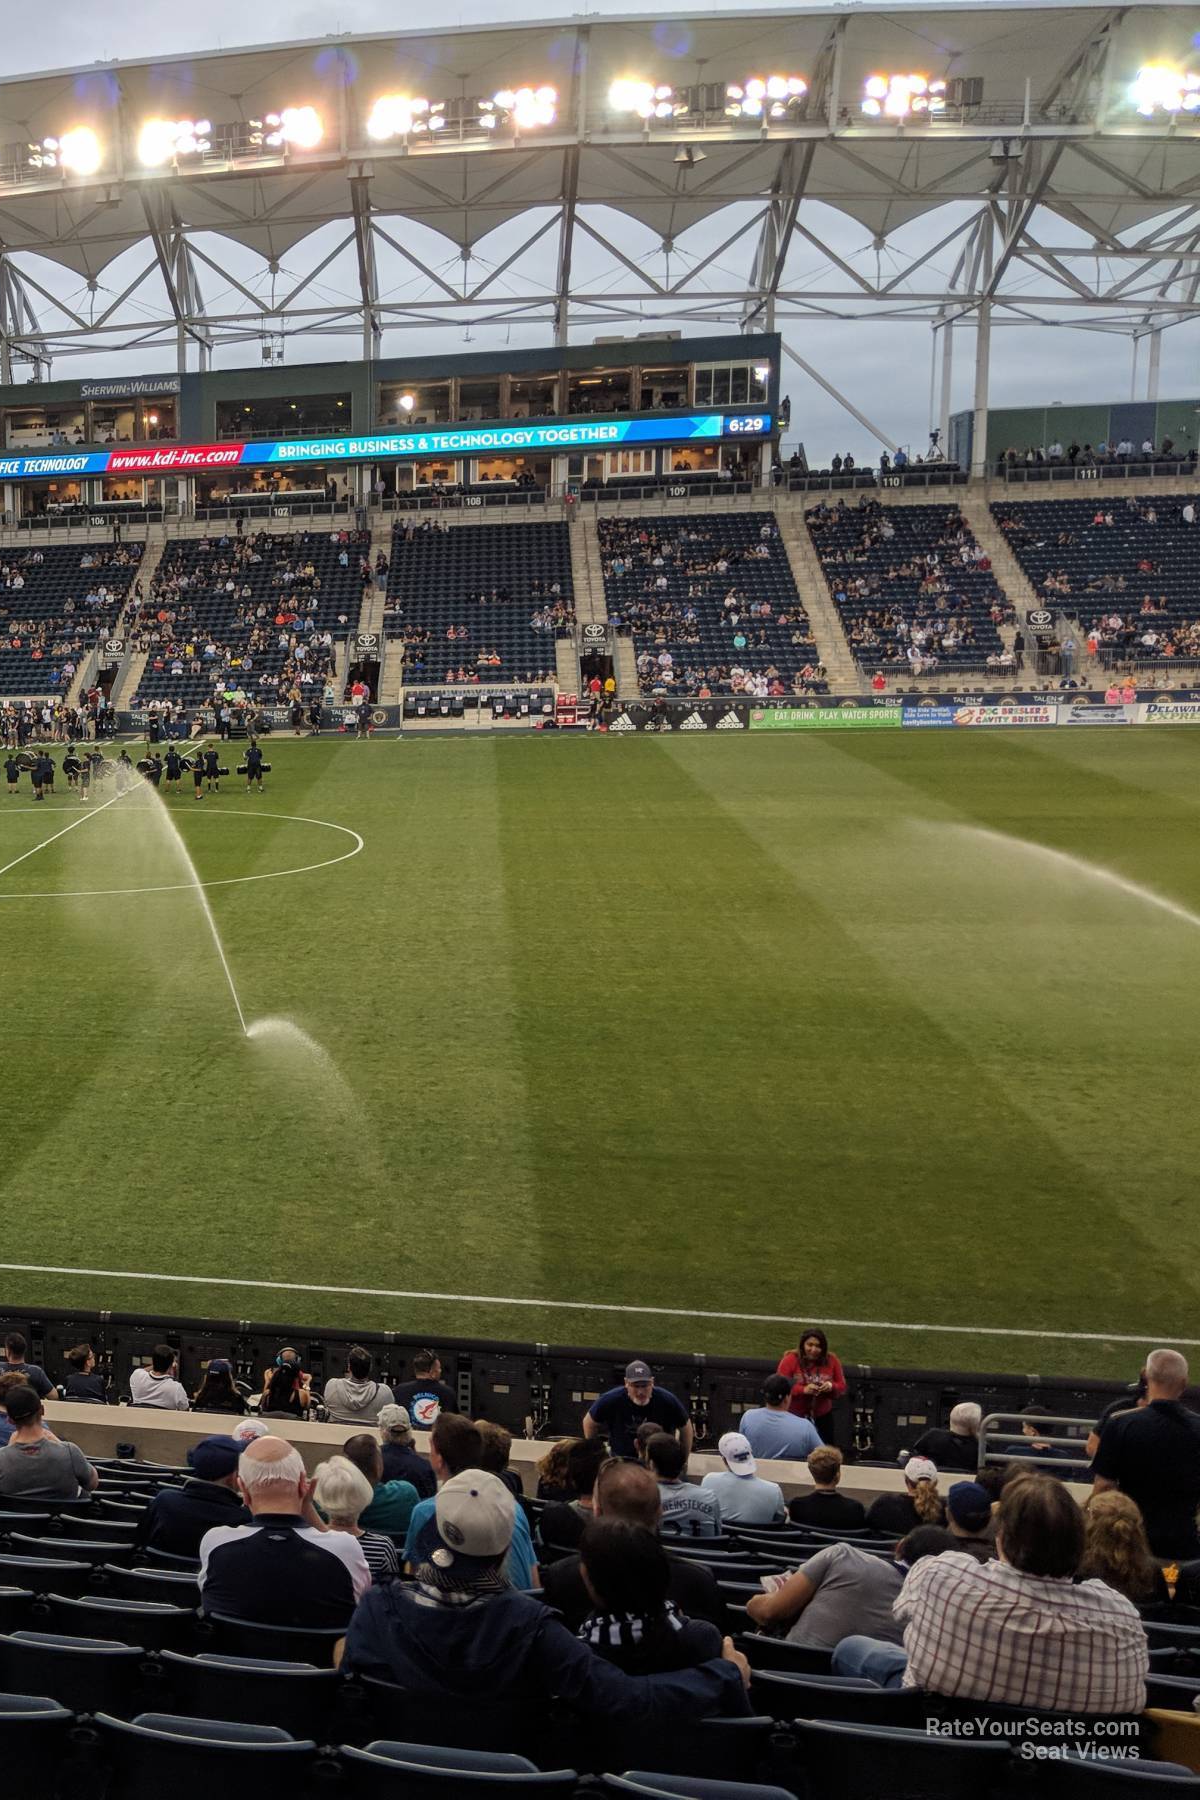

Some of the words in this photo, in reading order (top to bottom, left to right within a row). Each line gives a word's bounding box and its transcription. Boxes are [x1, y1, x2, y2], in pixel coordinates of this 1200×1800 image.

[729, 418, 763, 432] 6:29
[278, 443, 346, 458] BRINGING
[349, 439, 415, 454] BUSINESS
[418, 438, 429, 450] &
[432, 430, 533, 448] TECHNOLOGY
[539, 426, 618, 443] TOGETHER
[112, 449, 238, 468] www.kdi-inc.com
[23, 457, 89, 474] TECHNOLOGY
[1080, 470, 1098, 479] 111
[882, 477, 900, 488] 110
[669, 486, 687, 497] 109
[465, 497, 482, 506] 108
[273, 507, 289, 517] 107
[90, 516, 105, 525] 106
[842, 710, 866, 719] WATCH
[1012, 715, 1049, 723] BUSTERS
